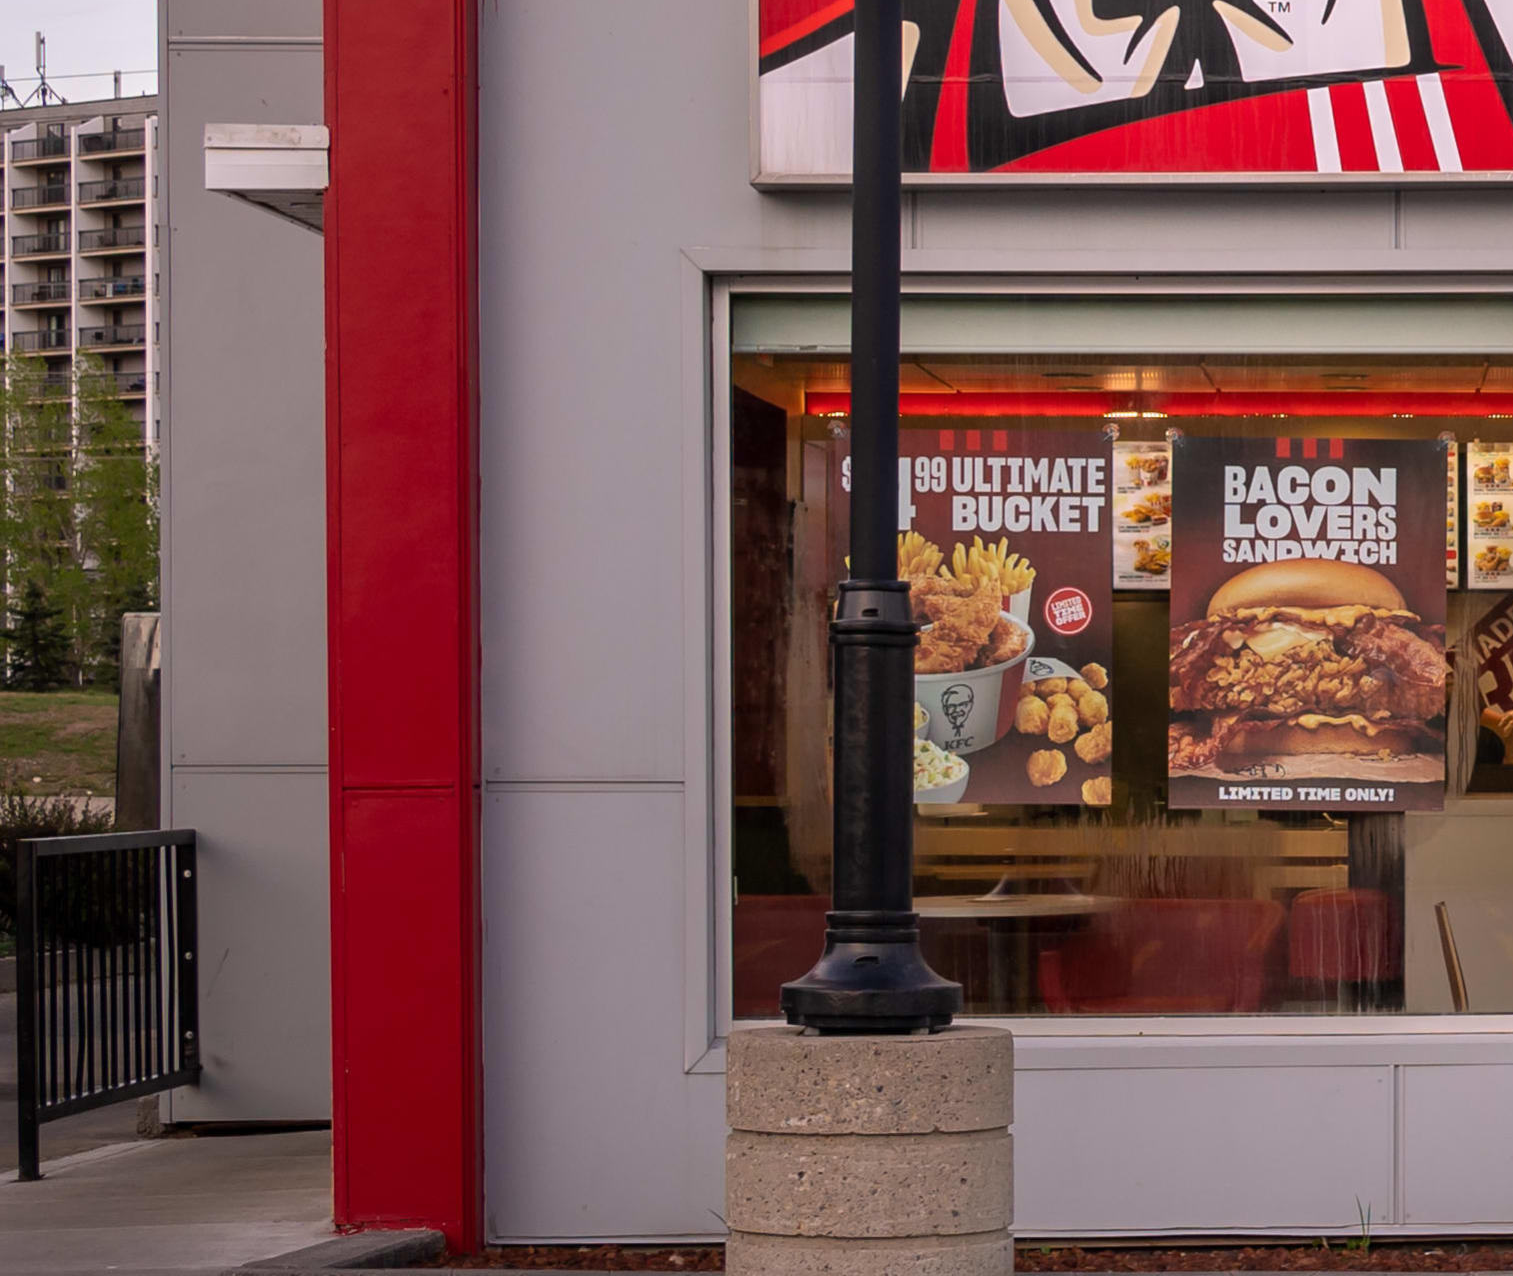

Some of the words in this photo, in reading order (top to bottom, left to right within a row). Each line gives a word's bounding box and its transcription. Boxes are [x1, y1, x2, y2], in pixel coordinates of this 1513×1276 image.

[1268, 1, 1291, 13] TM
[952, 456, 1105, 493] ULTIMATE
[1224, 465, 1397, 505] BACON
[952, 495, 1105, 532] BUCKET
[1223, 504, 1397, 540] LOVERS
[1222, 539, 1397, 564] SANDWICH
[1056, 611, 1087, 626] OFFER
[943, 735, 975, 752] KFC
[1218, 786, 1293, 801] LIMITED
[1297, 787, 1341, 801] TIME
[1345, 788, 1395, 802] ONLY!
